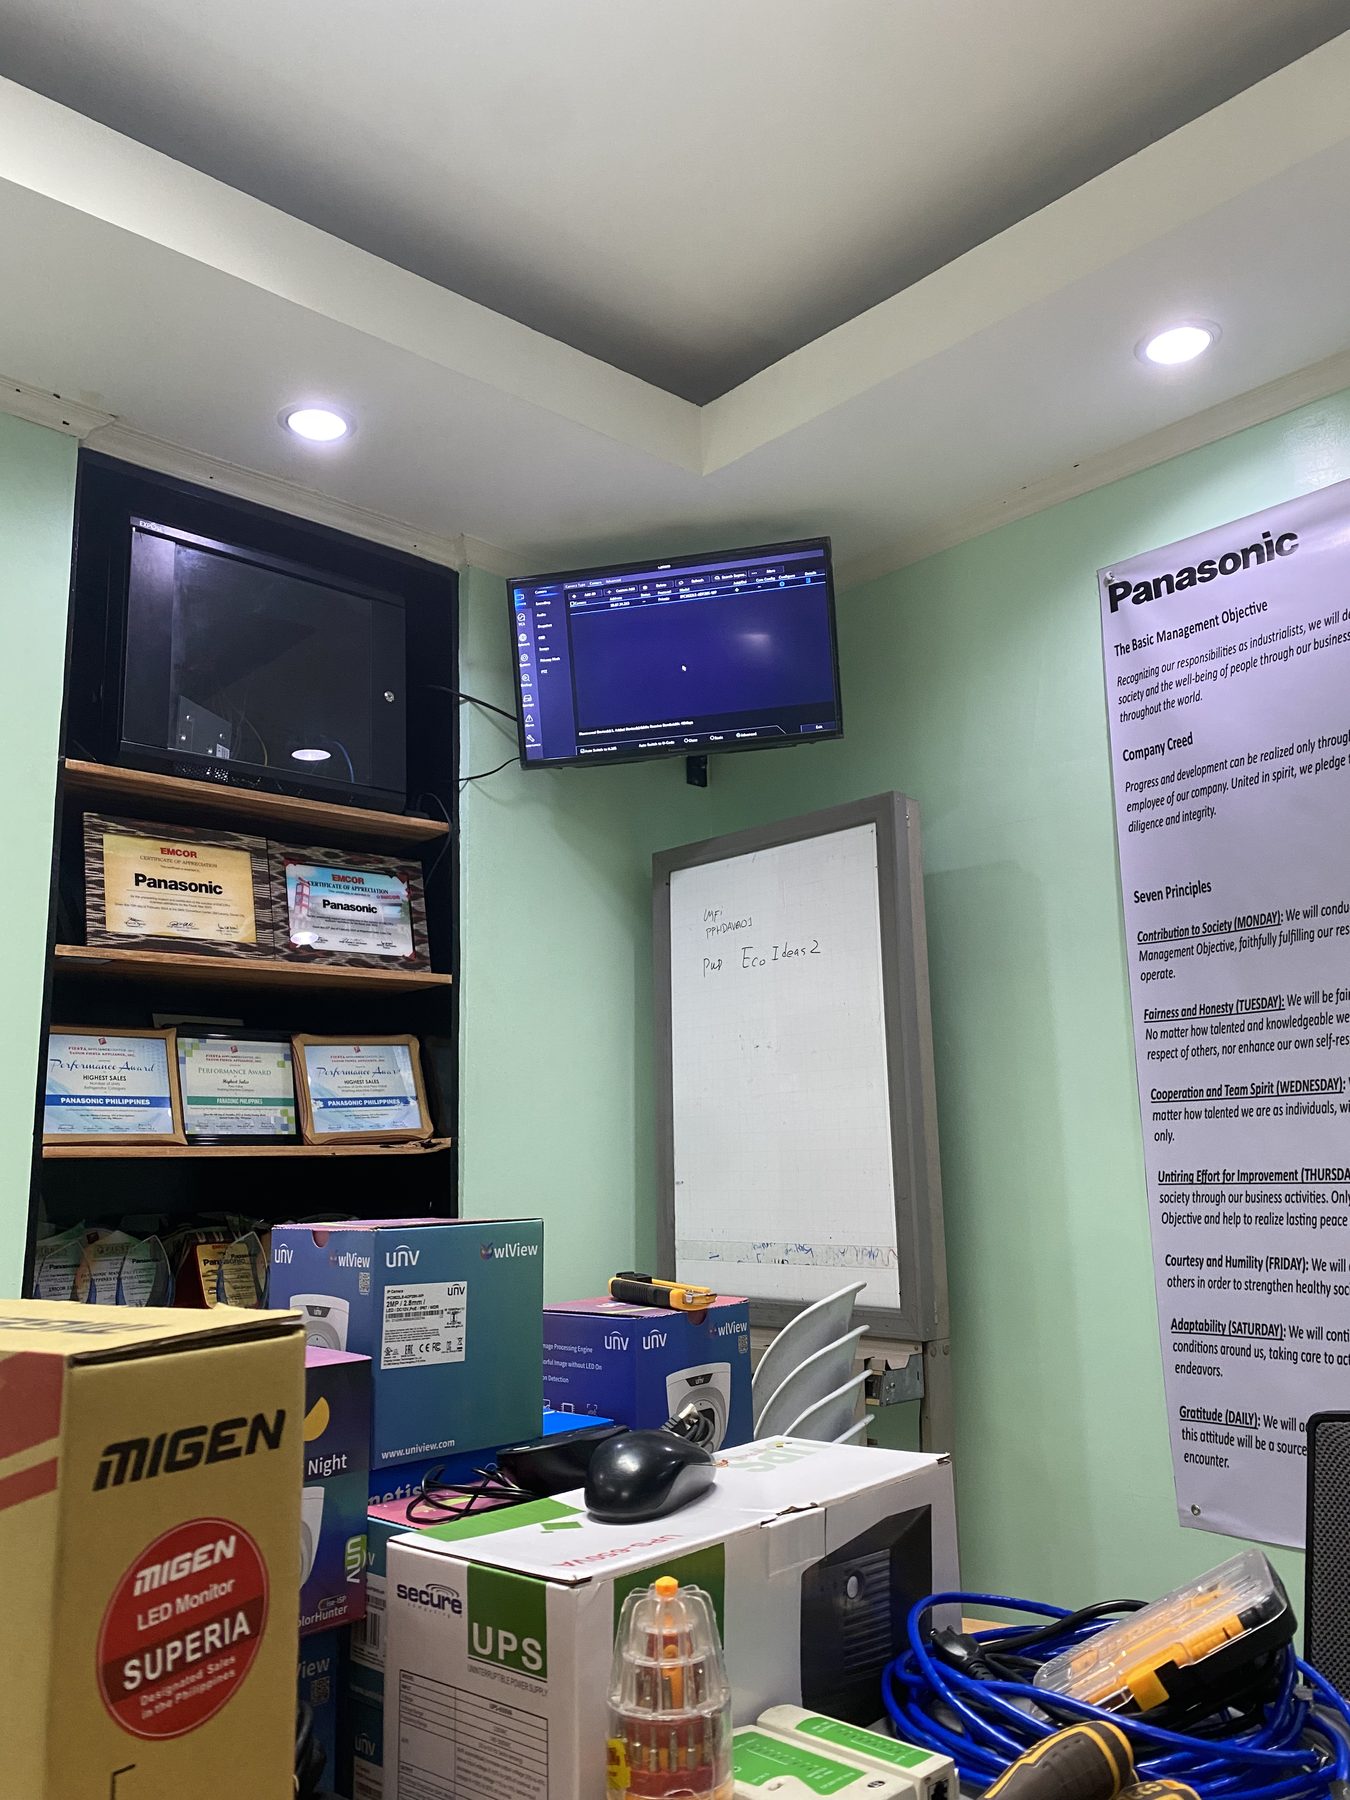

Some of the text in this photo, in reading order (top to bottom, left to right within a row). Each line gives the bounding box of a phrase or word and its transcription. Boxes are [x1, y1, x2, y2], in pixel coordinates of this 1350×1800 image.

[1108, 530, 1299, 613] Panasonic
[1116, 601, 1268, 656] The Basic Management Objective
[1116, 610, 1340, 687] Recognizing our responsibilities as industrialists, we will
[1122, 731, 1194, 762] Company Creed
[1125, 738, 1316, 793] Progress and development can be realized only
[1128, 805, 1216, 834] diligence and integrity.
[140, 855, 173, 864] CERTIFICATE
[160, 847, 197, 858] EMCOR
[134, 873, 223, 895] Panasonic
[309, 881, 342, 890] CERTIFICATE
[351, 885, 389, 894] APPRECIATION
[332, 874, 364, 884] EMCOR
[1133, 881, 1212, 904] Seven Principles
[322, 899, 377, 914] Panasonic
[1136, 904, 1318, 942] Contribution to Society (MONDAY): We will
[741, 946, 766, 968] Eco
[1140, 968, 1176, 984] operate.
[1143, 990, 1334, 1020] Fairness and Honesty (TUESDAY): We will be
[49, 1058, 155, 1073] Performance Award
[316, 1066, 370, 1077] Performance
[1150, 1077, 1346, 1102] Cooperation and Team Spirit (WEDNESDAY):
[1158, 1169, 1299, 1185] Untiring Effort for Improvement
[1164, 1254, 1346, 1274] Courtesy and Humility (FRIDAY): We will
[1170, 1319, 1324, 1340] Adaptability (SATURDAY): We will
[554, 1344, 578, 1353] Processing
[577, 1346, 593, 1354] Engine
[568, 1361, 585, 1369] without
[585, 1362, 594, 1370] LED
[1174, 1361, 1223, 1377] endeavors.
[548, 1375, 569, 1383] Detection
[1179, 1406, 1297, 1430] Gratitude (DAILY): We will
[92, 1409, 286, 1492] MIGEN
[381, 1439, 455, 1460] www.uniview.com
[1183, 1452, 1230, 1468] encounter.
[307, 1453, 348, 1477] Night
[133, 1535, 236, 1597] MIGEN
[137, 1579, 235, 1631] LED Monitor
[396, 1583, 463, 1615] secure
[122, 1611, 251, 1690] SUPERIA
[472, 1622, 543, 1671] UPS
[140, 1655, 236, 1706] Designated Sales
[154, 1699, 173, 1714] the
[175, 1669, 236, 1704] Philippines
